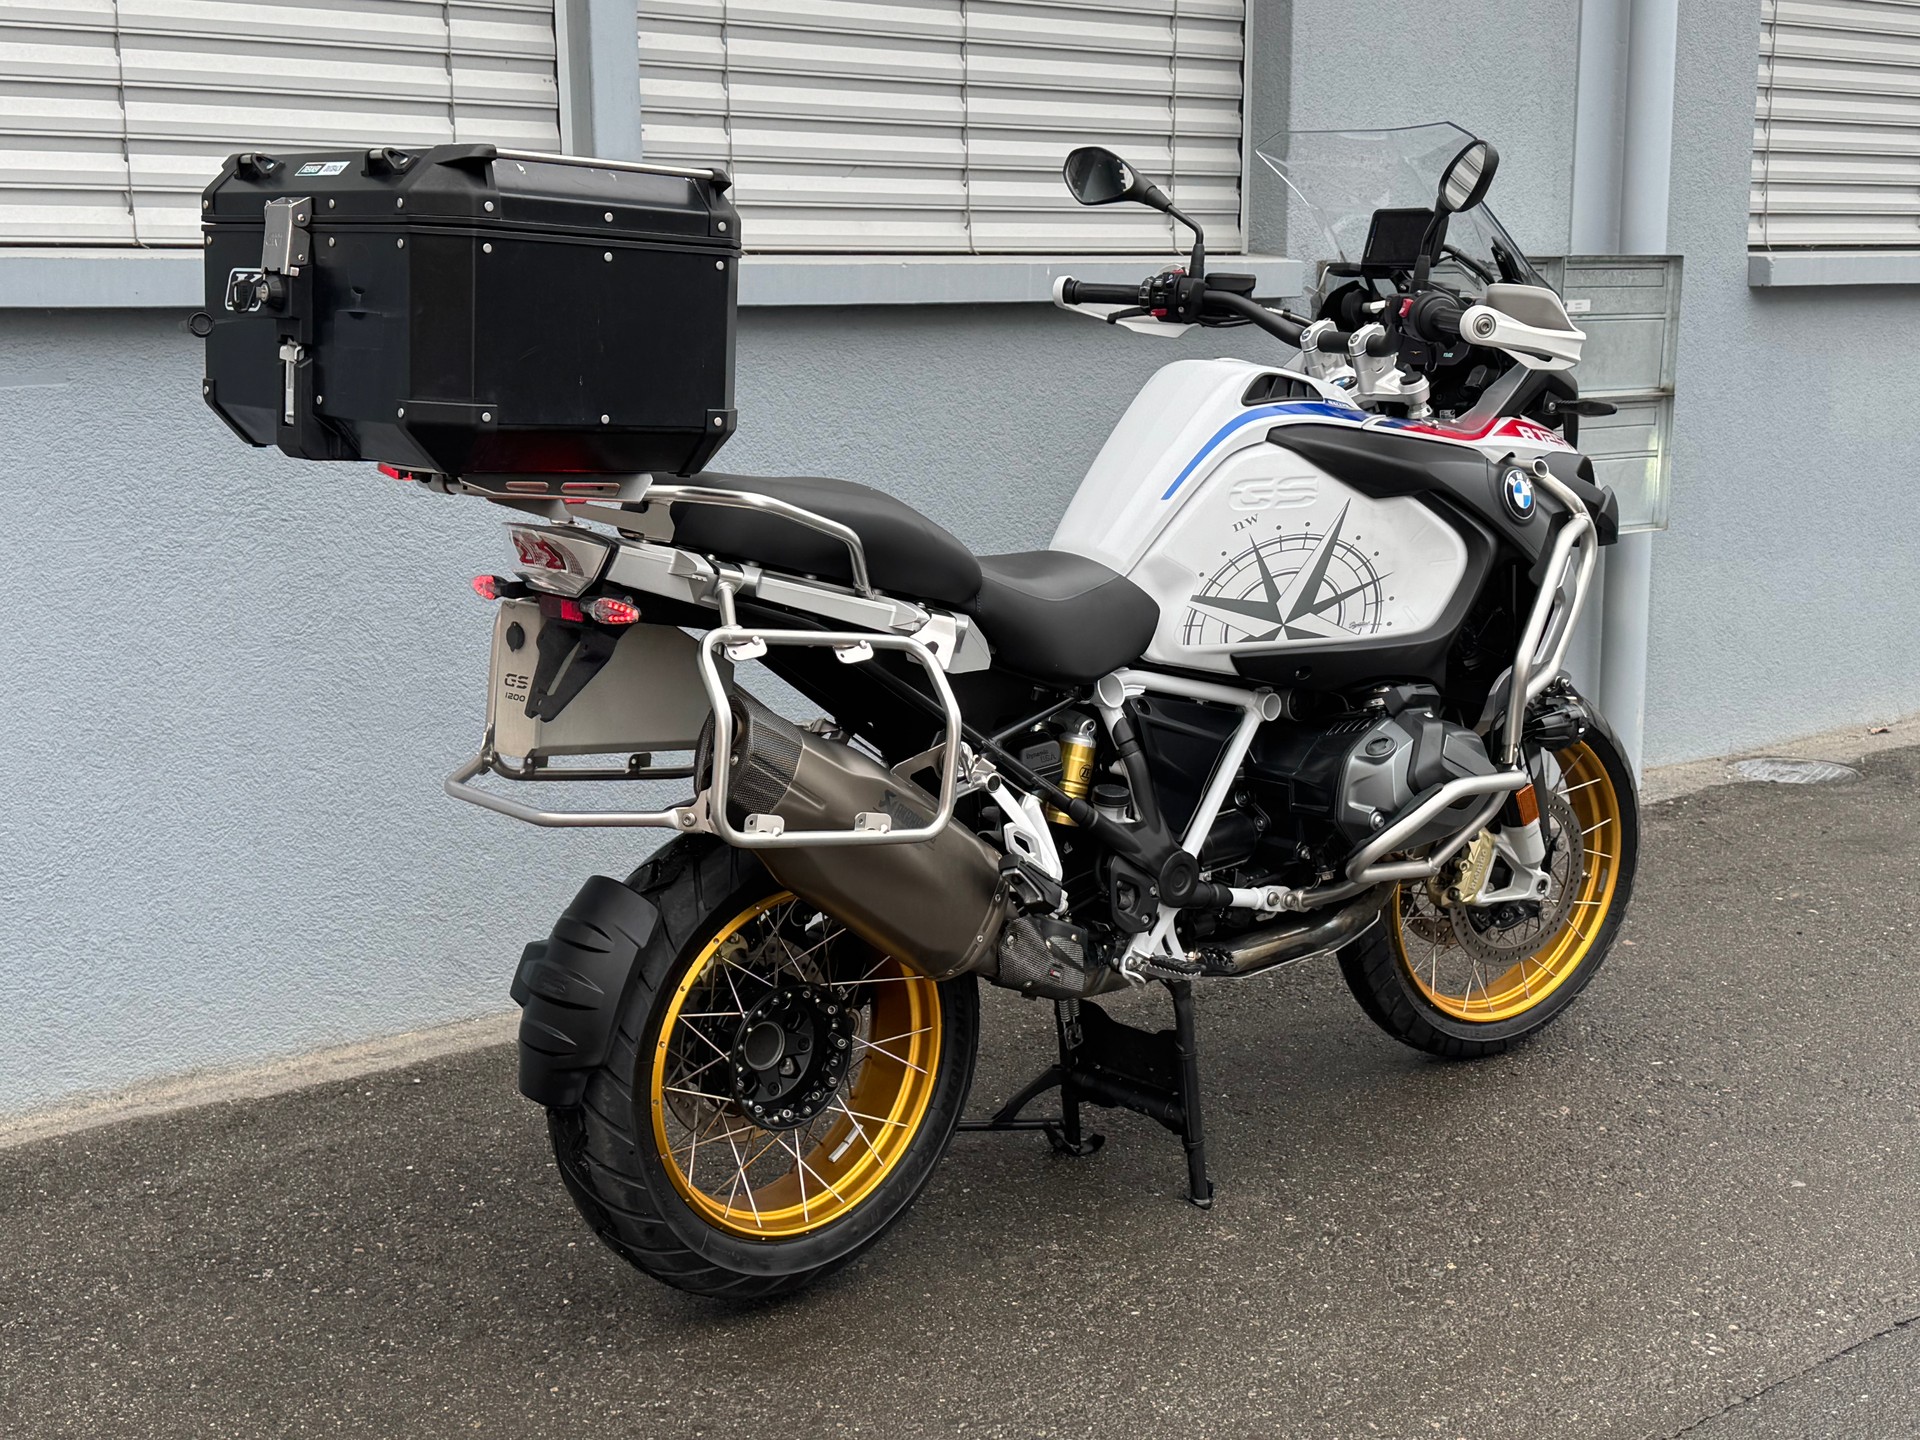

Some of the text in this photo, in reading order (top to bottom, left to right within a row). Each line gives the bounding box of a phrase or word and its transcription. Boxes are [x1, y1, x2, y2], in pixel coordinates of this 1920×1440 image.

[1508, 472, 1533, 489] BMW
[1228, 475, 1319, 511] GS
[1232, 513, 1259, 532] nw
[505, 672, 528, 689] GS
[505, 692, 526, 702] 1200
